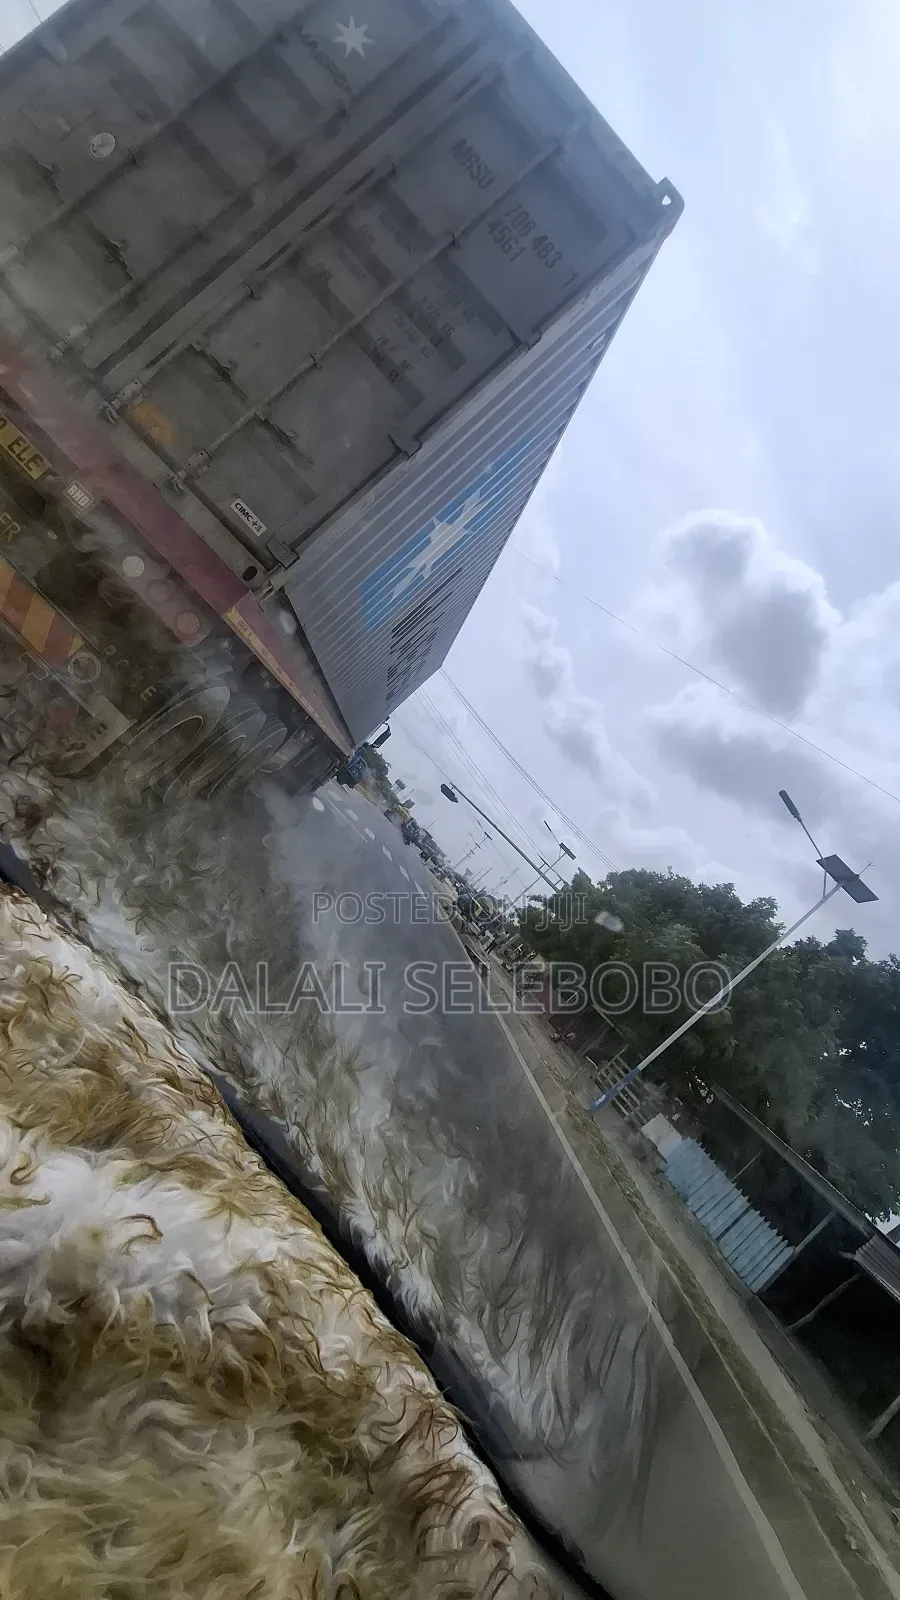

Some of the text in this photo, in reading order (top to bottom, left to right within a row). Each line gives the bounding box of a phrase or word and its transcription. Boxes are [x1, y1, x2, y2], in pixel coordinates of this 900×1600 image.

[452, 137, 496, 189] MRSU
[504, 202, 536, 237] 706
[532, 234, 562, 268] 483
[487, 219, 526, 261] 45G1
[7, 436, 44, 472] ELE
[235, 502, 254, 522] CIMC
